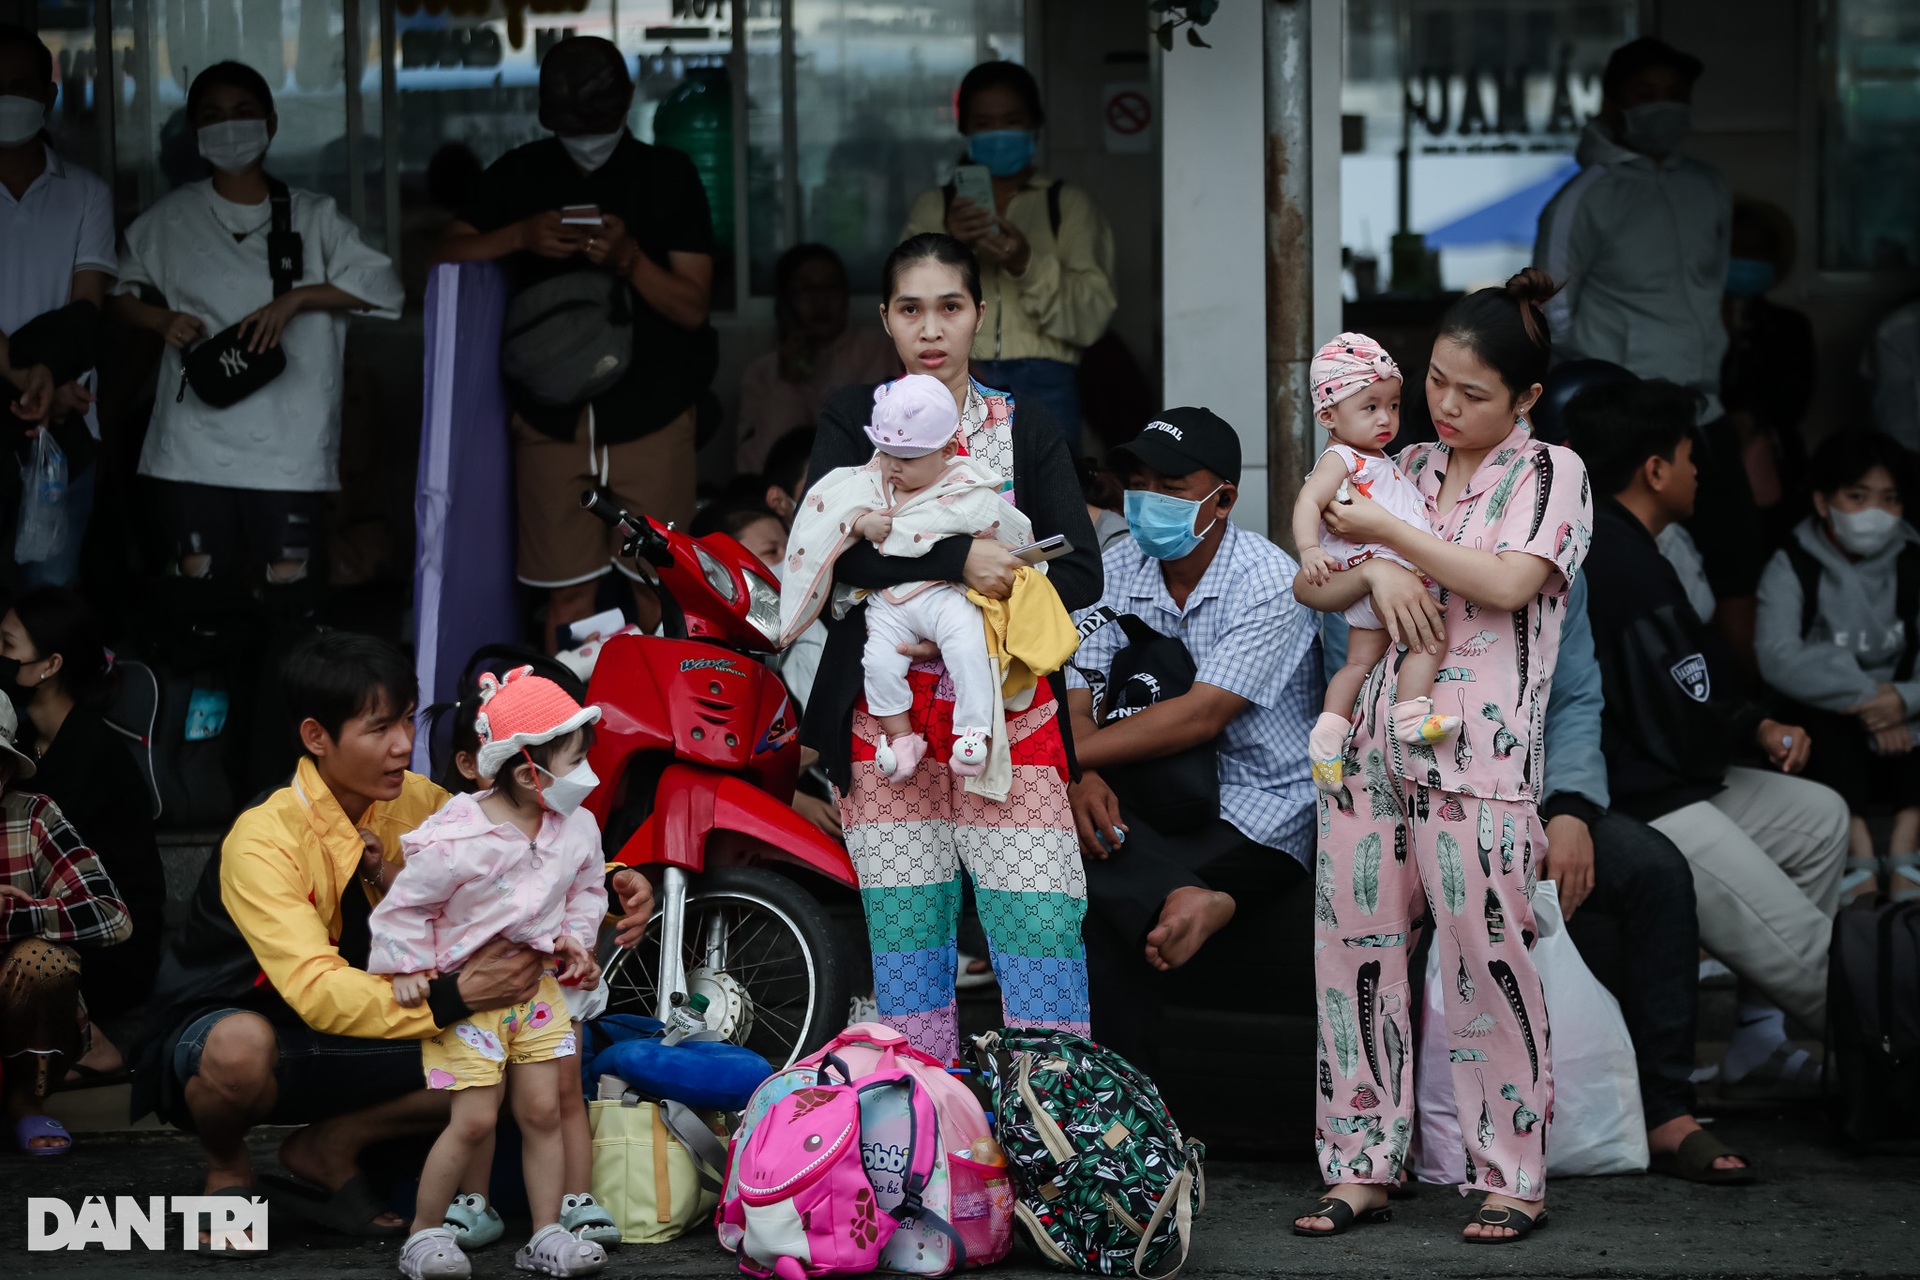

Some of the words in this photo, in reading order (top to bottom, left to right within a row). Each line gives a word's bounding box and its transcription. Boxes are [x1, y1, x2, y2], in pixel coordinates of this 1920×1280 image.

[218, 347, 248, 378] NY
[1348, 554, 1369, 567] LOVE
[680, 658, 737, 673] Wave
[714, 665, 748, 678] HONDA
[766, 716, 788, 743] S
[886, 1180, 900, 1195] bé
